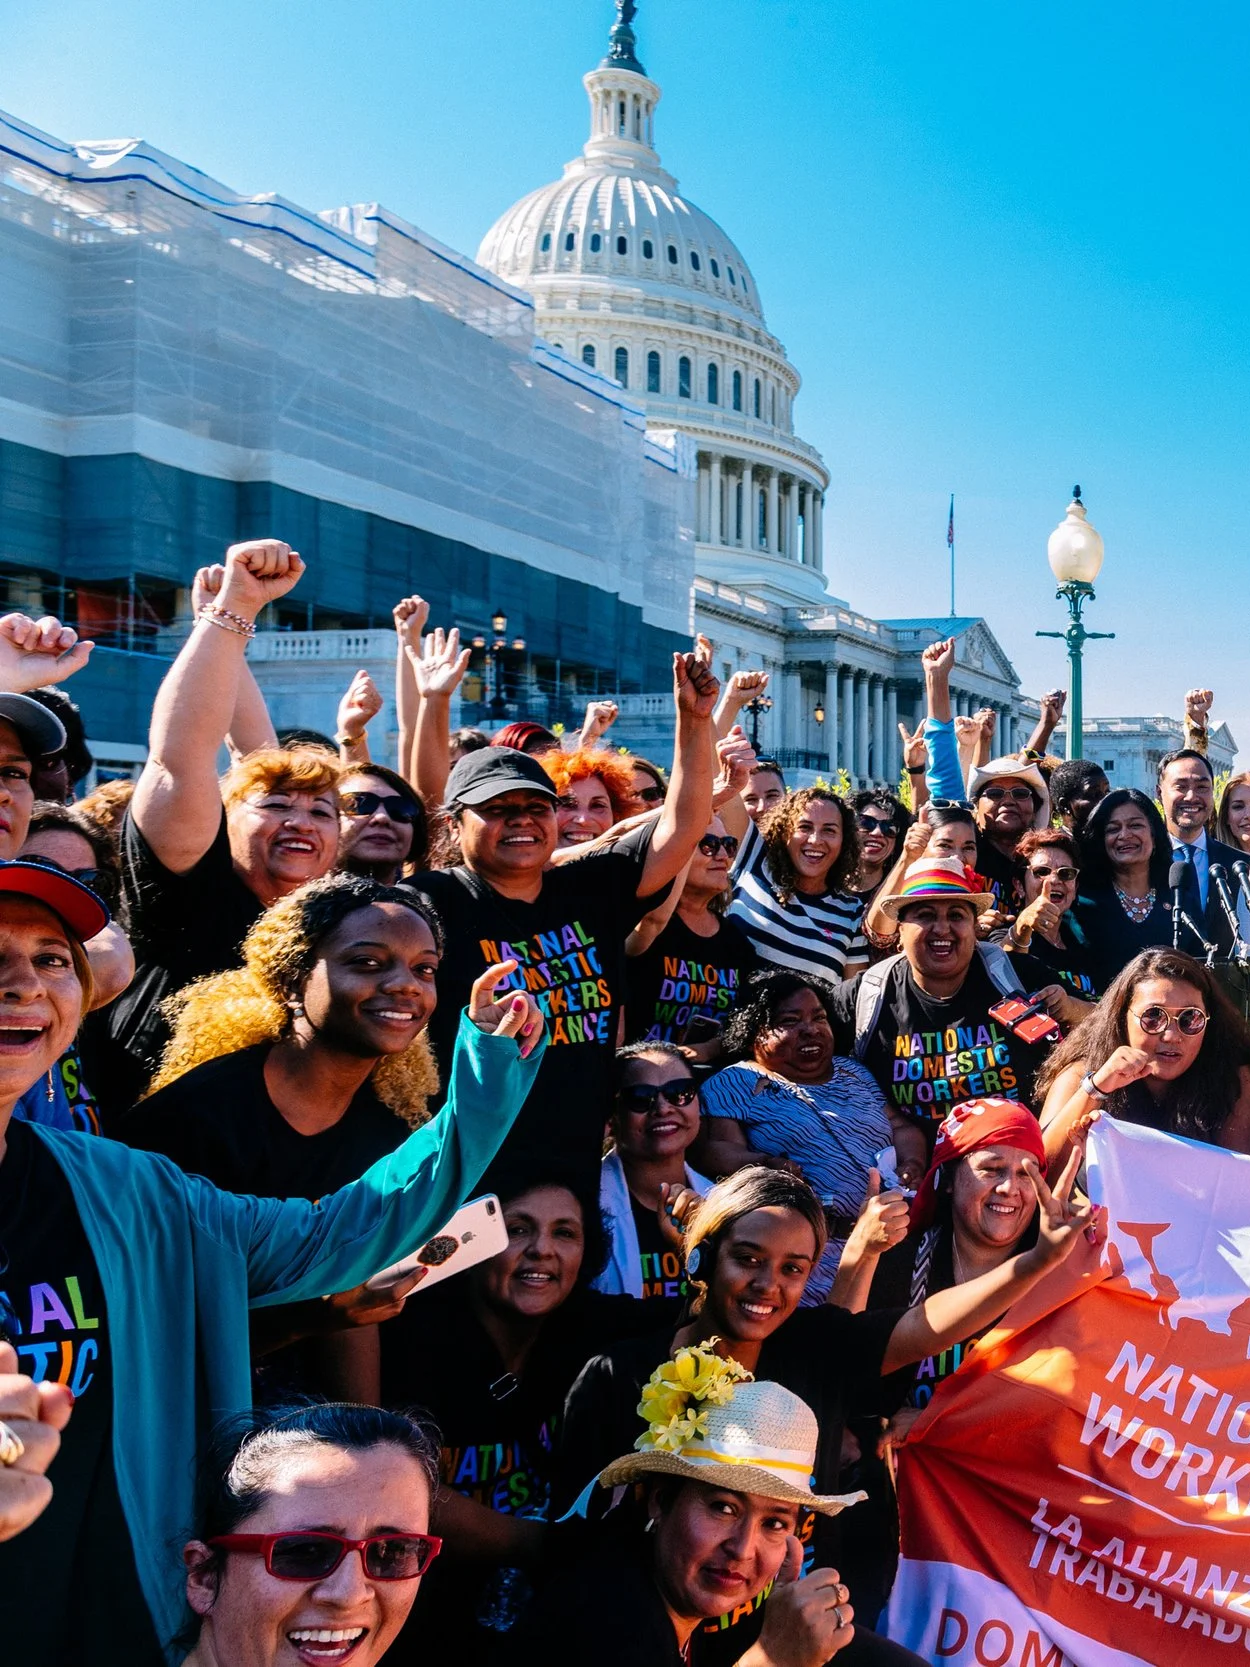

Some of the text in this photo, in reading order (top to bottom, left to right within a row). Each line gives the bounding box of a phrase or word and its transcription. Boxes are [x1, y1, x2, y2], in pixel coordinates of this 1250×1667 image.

[895, 1023, 1006, 1058] NATIONAL
[893, 1043, 1011, 1082] DOMESTIC
[892, 1066, 1018, 1105] WORKERS
[1030, 1498, 1084, 1546] LA
